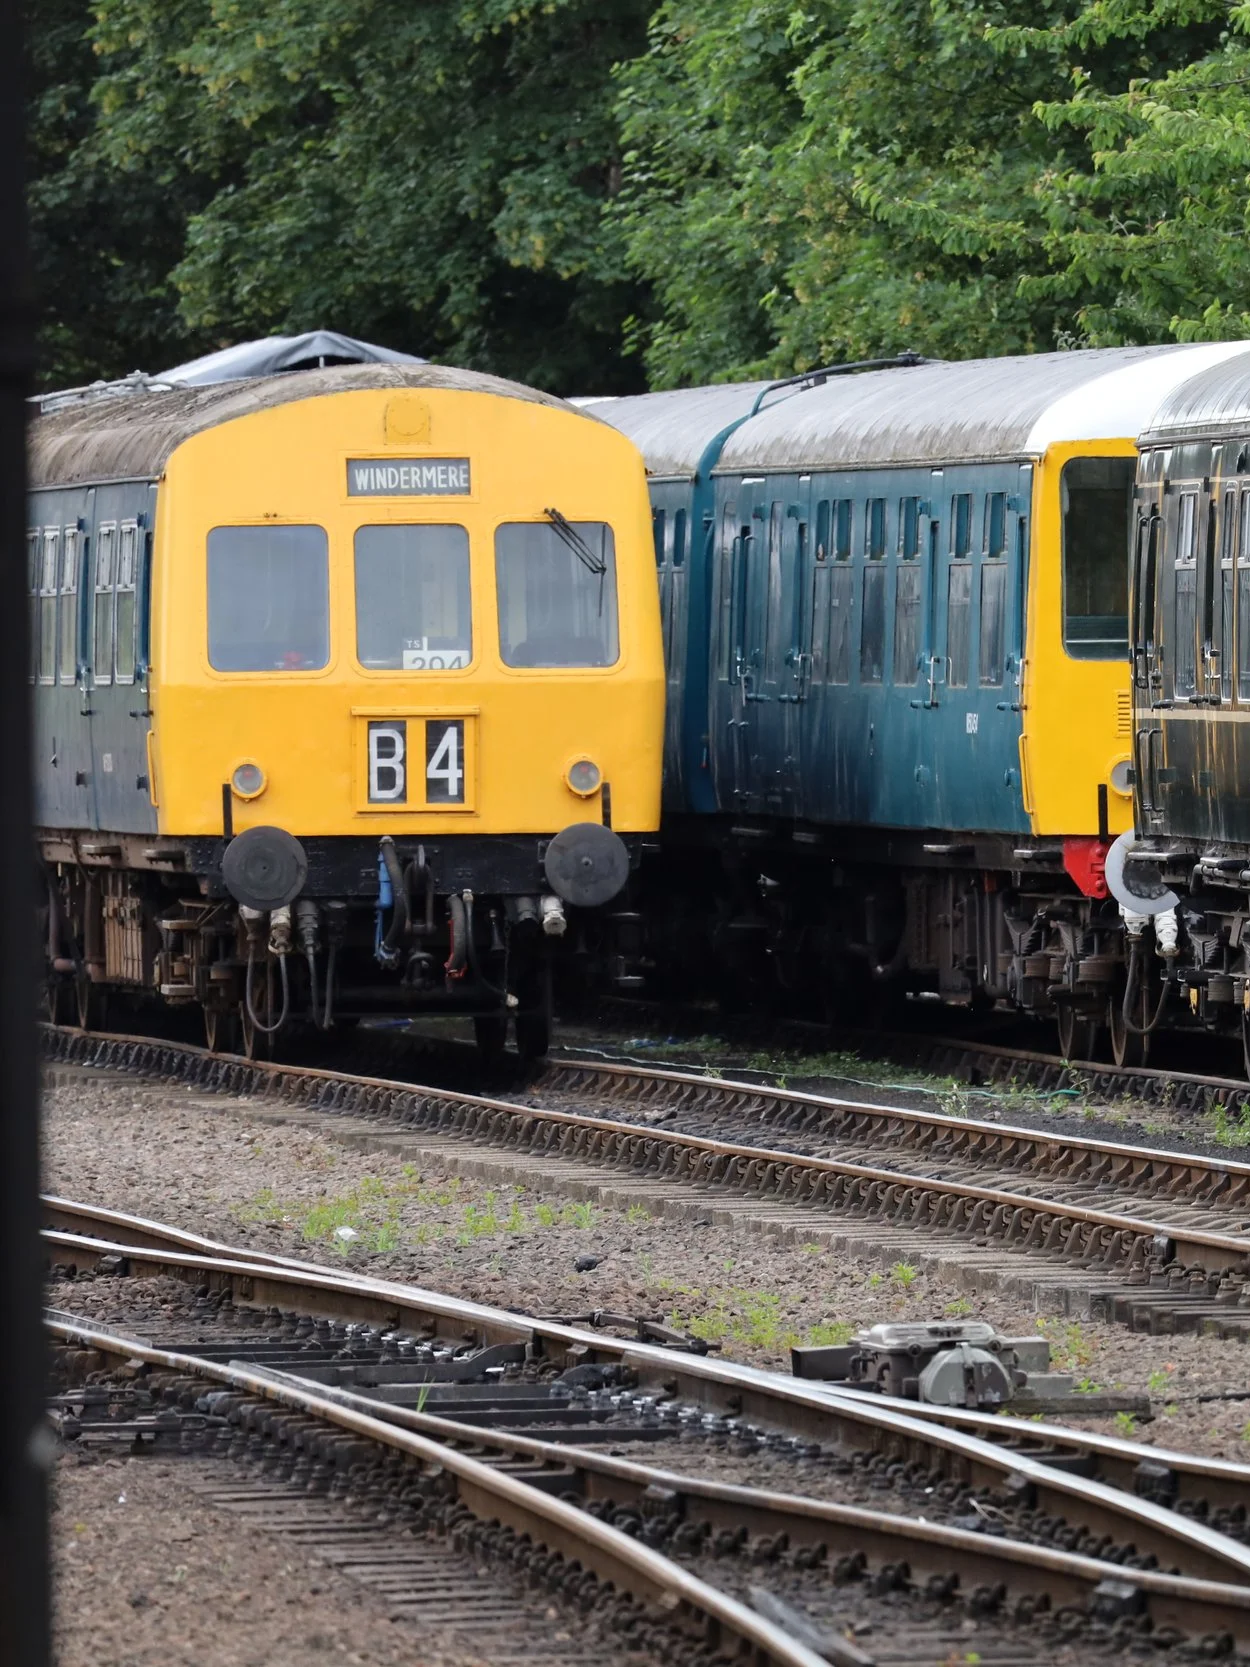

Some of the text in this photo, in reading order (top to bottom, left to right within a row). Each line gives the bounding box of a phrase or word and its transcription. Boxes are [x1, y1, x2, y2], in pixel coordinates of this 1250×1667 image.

[355, 465, 469, 491] WINDERMERE
[369, 726, 463, 799] B 4
